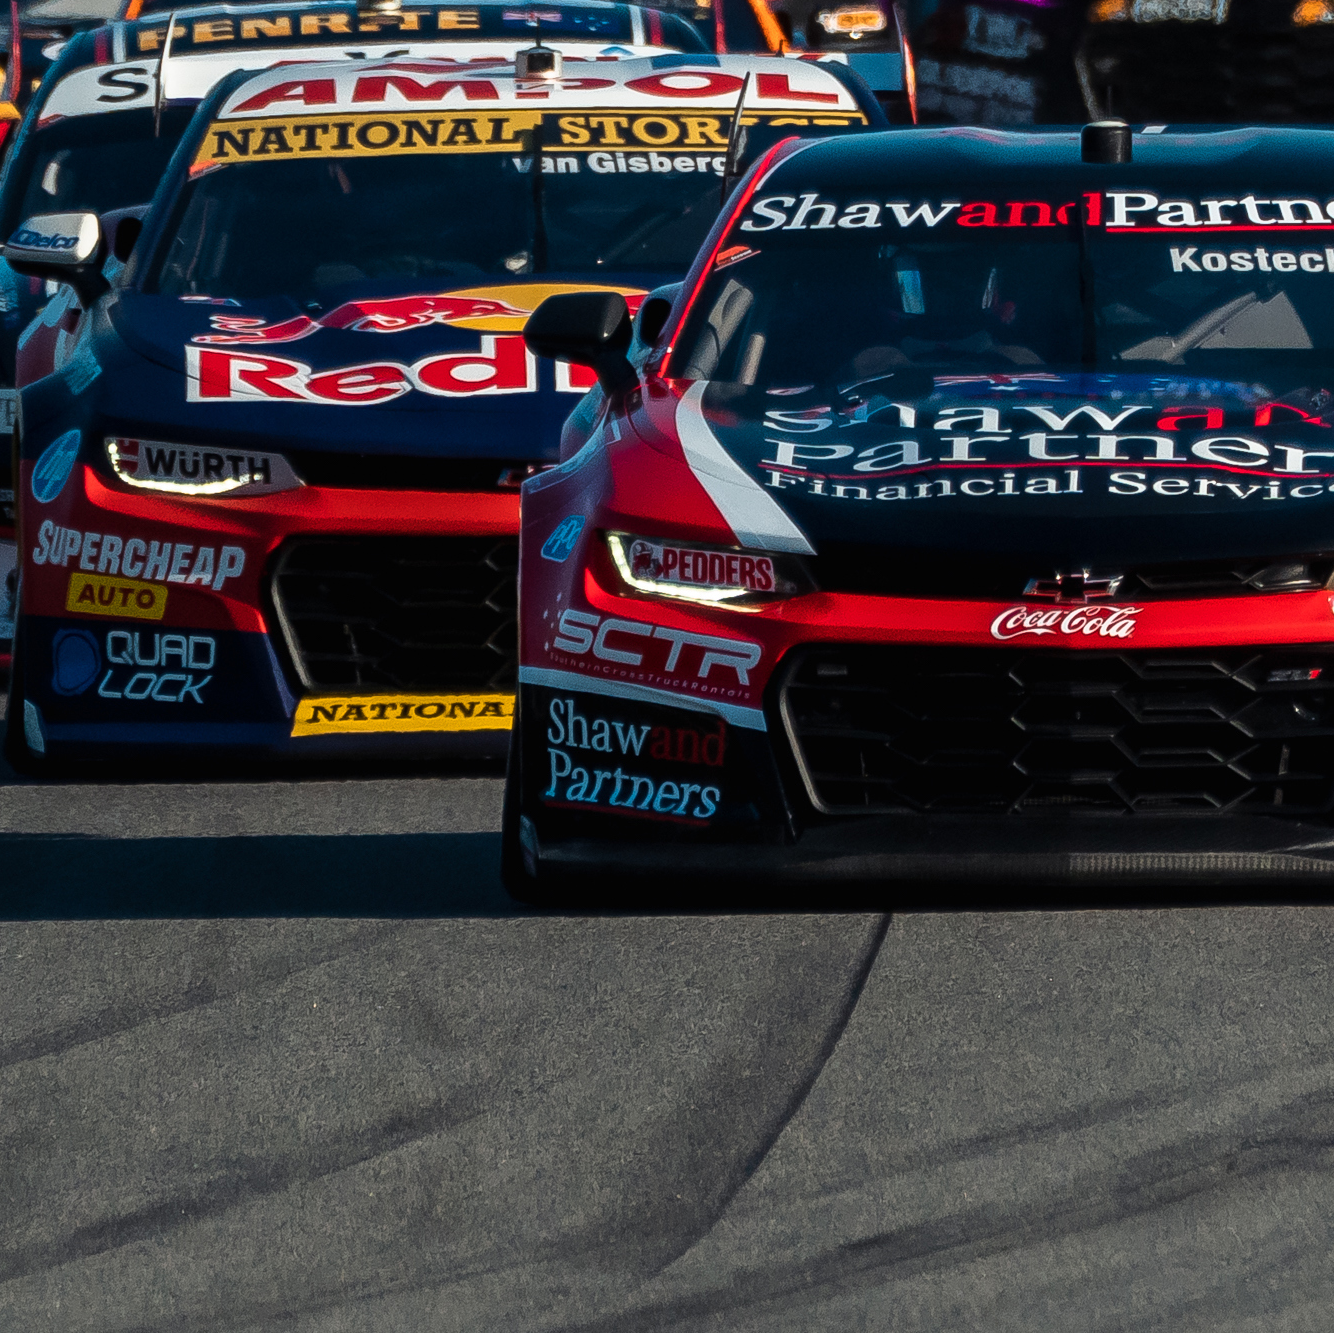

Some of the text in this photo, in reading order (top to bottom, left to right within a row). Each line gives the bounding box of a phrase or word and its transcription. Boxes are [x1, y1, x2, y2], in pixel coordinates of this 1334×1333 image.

[212, 115, 521, 159] NATIONAL
[185, 335, 538, 404] Red
[764, 469, 1084, 501] Financial
[32, 519, 247, 591] SUPERCHEAP
[662, 548, 774, 593] PEDDERS
[77, 583, 156, 610] AUTO
[105, 630, 216, 671] QUAD
[553, 608, 763, 686] SCTR
[97, 669, 214, 704] LOCK
[545, 747, 721, 819] Partners
